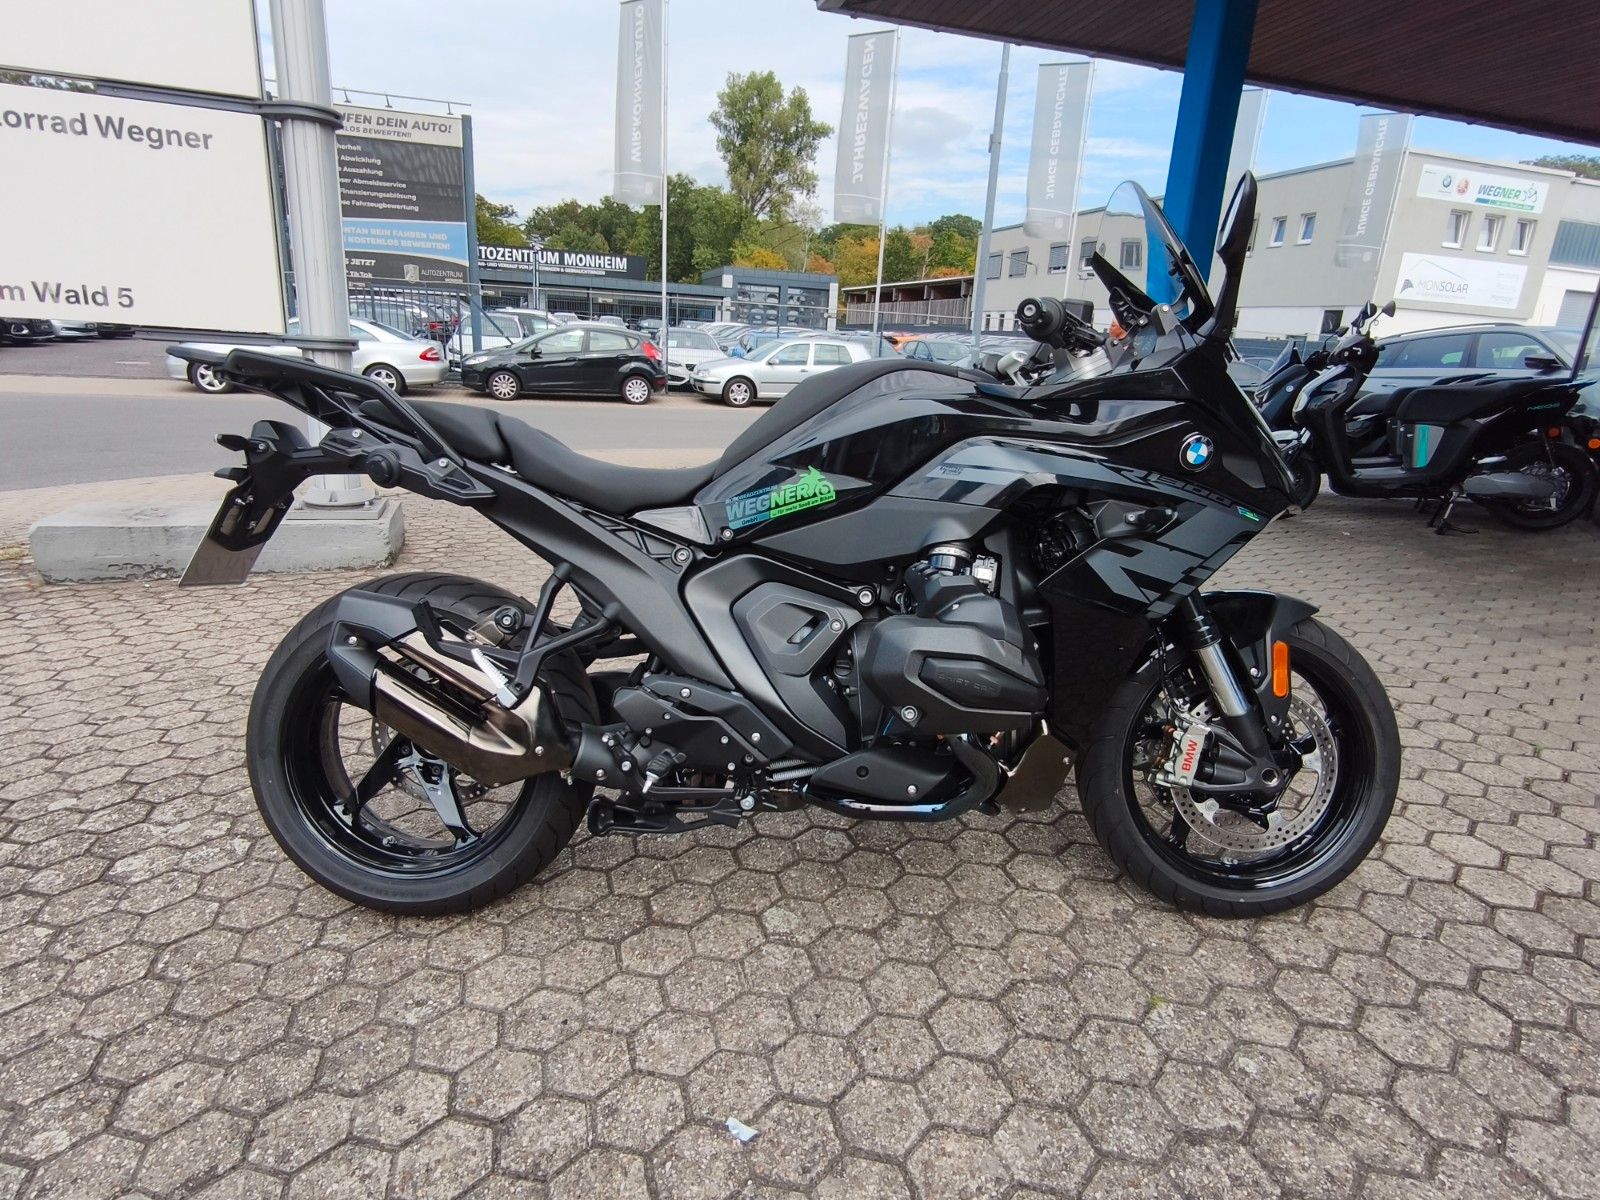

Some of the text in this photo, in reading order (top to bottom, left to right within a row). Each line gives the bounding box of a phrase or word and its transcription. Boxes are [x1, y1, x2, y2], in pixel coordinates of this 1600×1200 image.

[94, 114, 213, 150] Wegner
[376, 116, 408, 129] DEIN
[412, 121, 452, 133] AUTO!
[340, 155, 381, 165] Abwicklung
[343, 167, 383, 176] Auszahlung
[1478, 184, 1521, 199] WEGNER
[564, 253, 627, 270] MONHEIM
[421, 269, 463, 278] AUTOZENTRUM
[31, 281, 109, 306] Wald
[117, 287, 134, 308] 5
[1417, 279, 1469, 294] MONSOLAR
[726, 484, 810, 520] WEGNER
[741, 516, 758, 525] GmbH
[1181, 739, 1198, 771] BMW
